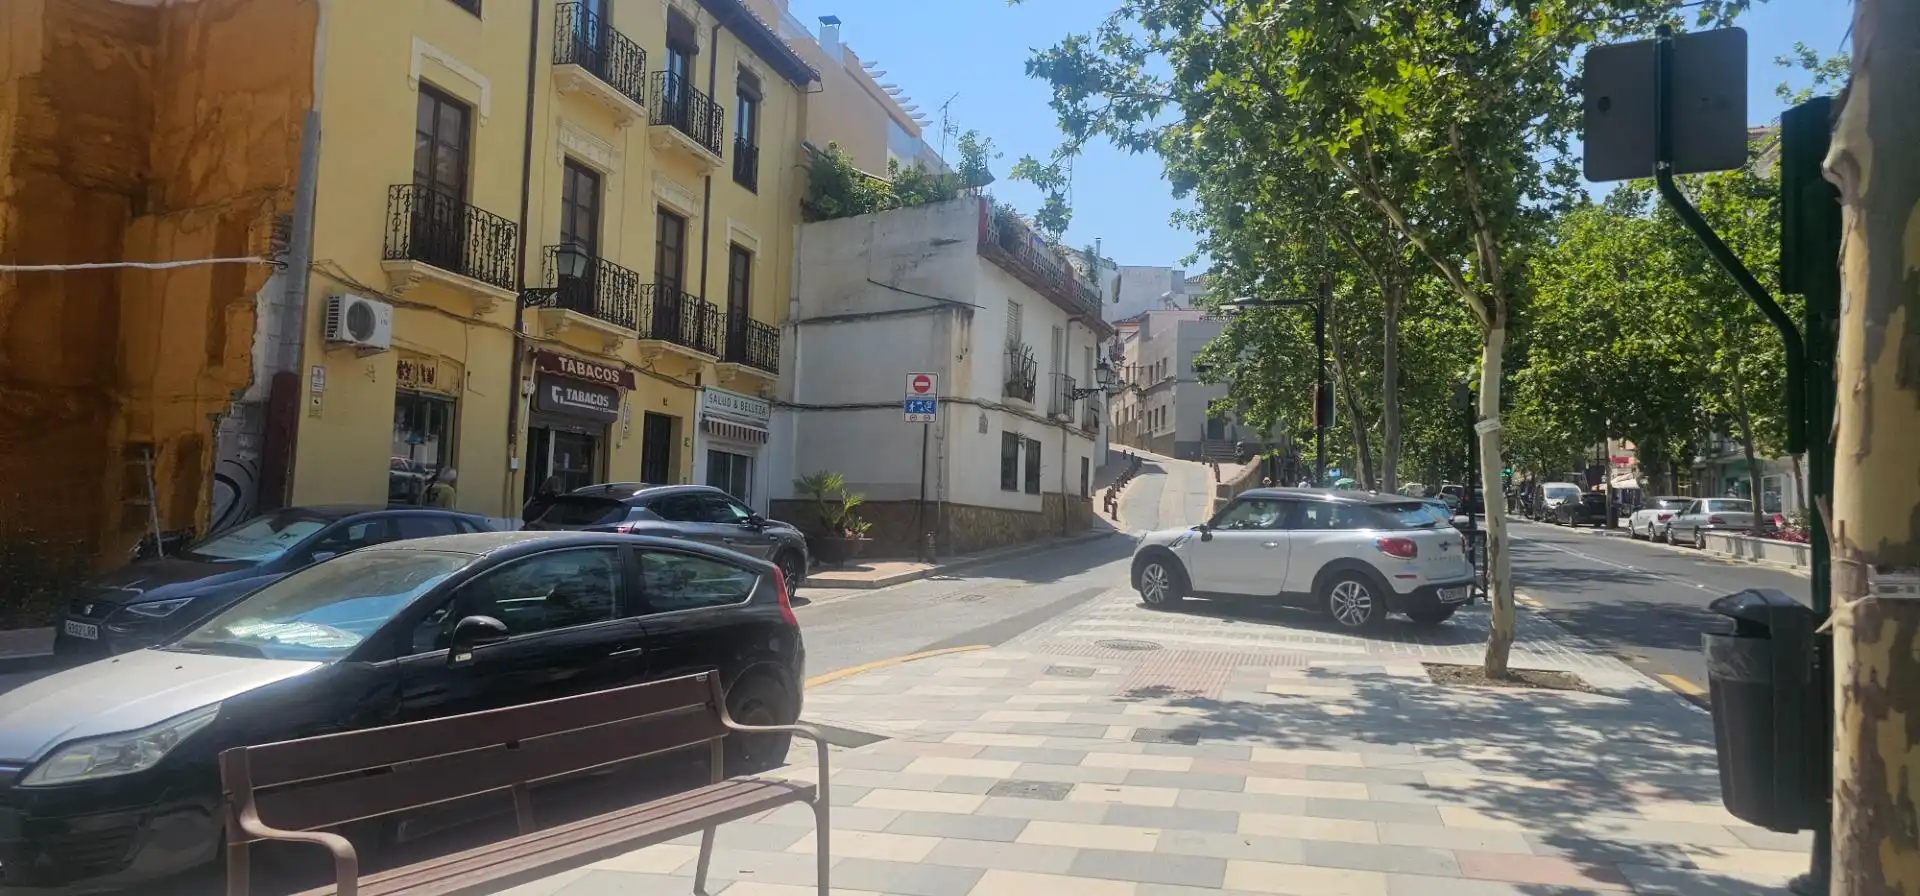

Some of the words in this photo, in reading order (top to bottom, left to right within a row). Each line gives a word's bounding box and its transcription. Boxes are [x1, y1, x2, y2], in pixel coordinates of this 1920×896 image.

[558, 356, 619, 382] TABACOS
[566, 387, 609, 407] TABACOS
[709, 393, 731, 408] SALUD
[740, 400, 766, 416] BELLEZA
